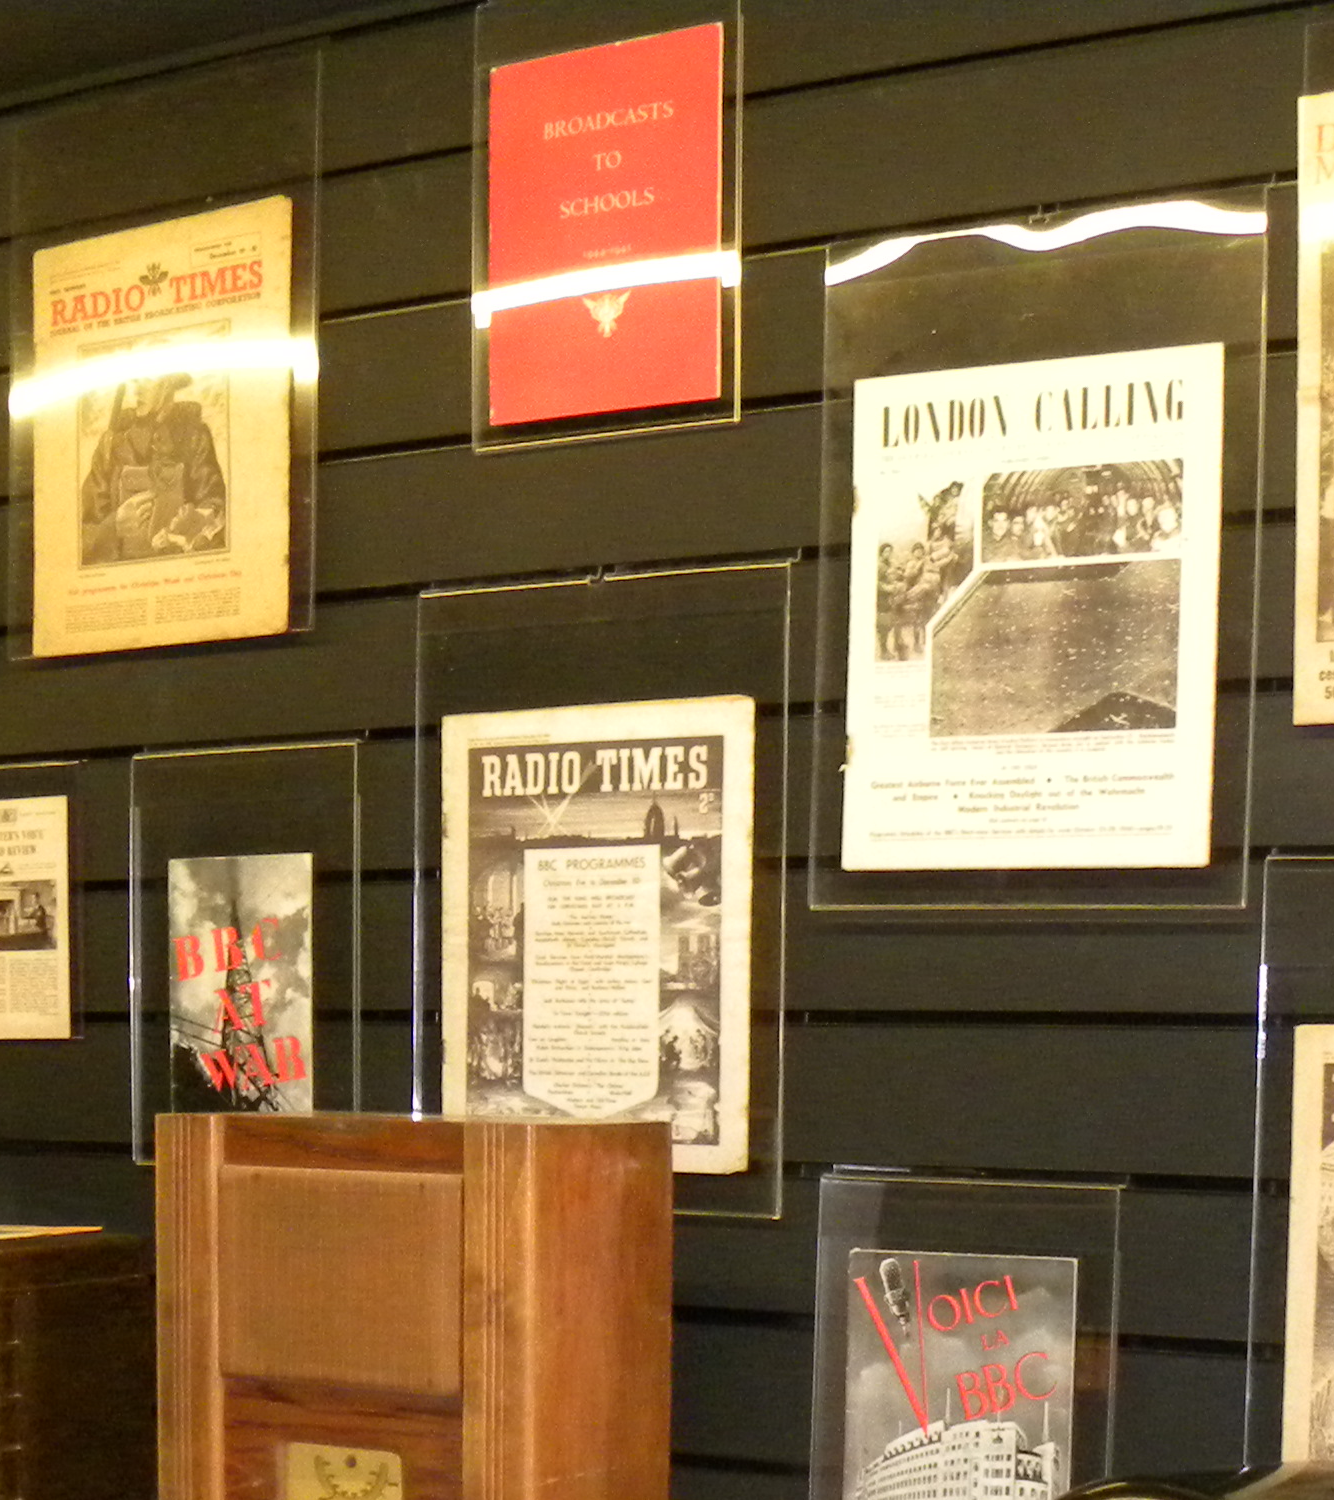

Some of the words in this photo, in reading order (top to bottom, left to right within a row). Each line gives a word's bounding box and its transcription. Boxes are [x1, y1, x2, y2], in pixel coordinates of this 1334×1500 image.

[543, 101, 674, 141] BROADCASTS
[594, 150, 622, 171] TO
[559, 187, 655, 219] SCHOOLS
[50, 284, 145, 327] RADIO
[169, 260, 263, 304] TIMES
[883, 395, 1007, 448] LONDON
[1035, 379, 1183, 433] CALLING
[482, 751, 581, 797] RADIO
[596, 745, 708, 792] TIMES
[538, 859, 557, 871] BBC
[566, 856, 646, 870] PROGRAMMES
[172, 917, 282, 982] BBC
[213, 980, 271, 1035] AT
[200, 1036, 307, 1092] WAR
[853, 1260, 1019, 1440] VOICI
[981, 1329, 1010, 1351] LA
[955, 1352, 1057, 1421] BBC
